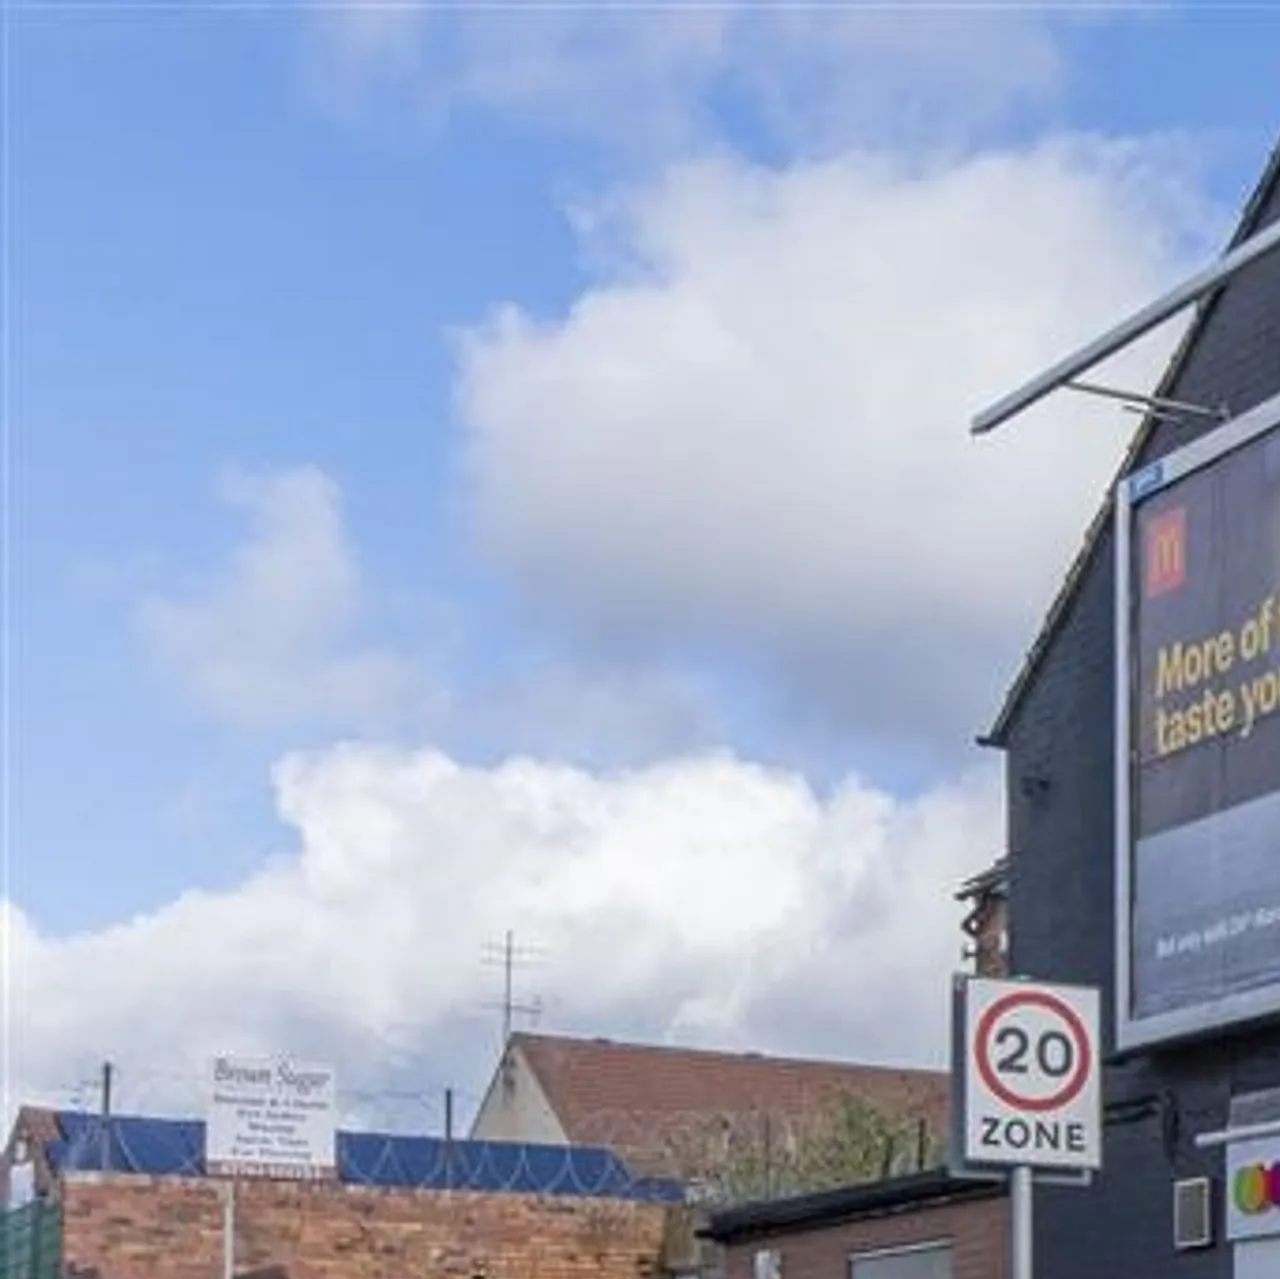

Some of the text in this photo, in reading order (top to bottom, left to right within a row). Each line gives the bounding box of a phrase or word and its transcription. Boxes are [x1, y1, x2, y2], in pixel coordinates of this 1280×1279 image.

[1156, 629, 1234, 698] More
[1240, 596, 1273, 660] of
[1156, 688, 1234, 755] taste
[213, 1057, 272, 1085] Brown
[996, 1027, 1073, 1077] 20
[981, 1117, 1086, 1153] ZONE
